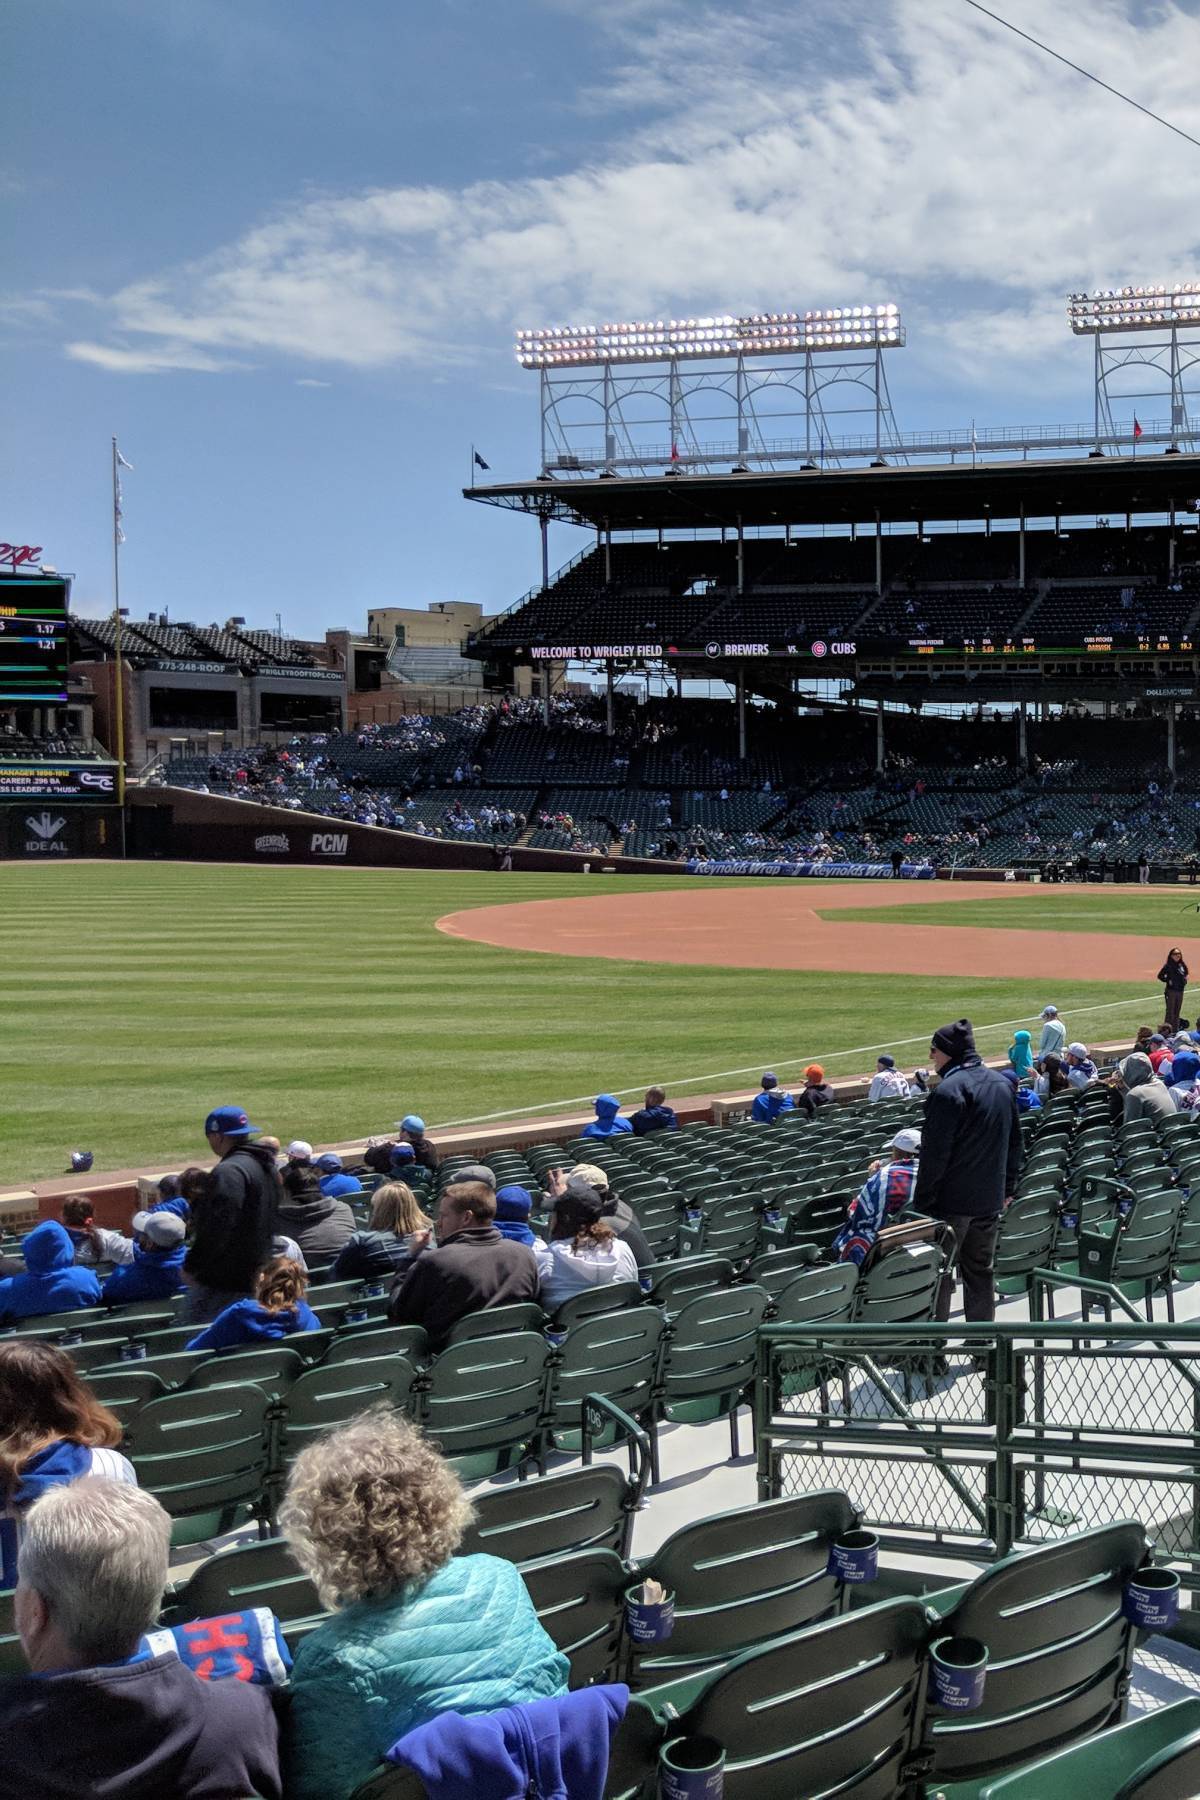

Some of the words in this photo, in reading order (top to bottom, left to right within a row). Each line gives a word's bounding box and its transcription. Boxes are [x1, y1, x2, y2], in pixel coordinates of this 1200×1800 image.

[531, 646, 577, 658] WELCOME
[578, 646, 592, 658] TO
[593, 645, 634, 658] WRIGLEY
[637, 645, 662, 657] FIELD
[724, 643, 769, 656] BREWERS
[831, 643, 856, 654] CUBS
[159, 661, 225, 673] 773-248-ROOF
[26, 842, 68, 851] IDEAL
[310, 833, 349, 852] PCM
[694, 862, 749, 875] Reynolds
[750, 862, 780, 876] Wrap
[808, 864, 864, 877] Reynolds
[586, 1406, 602, 1428] 106
[943, 1695, 968, 1706] Hefty
